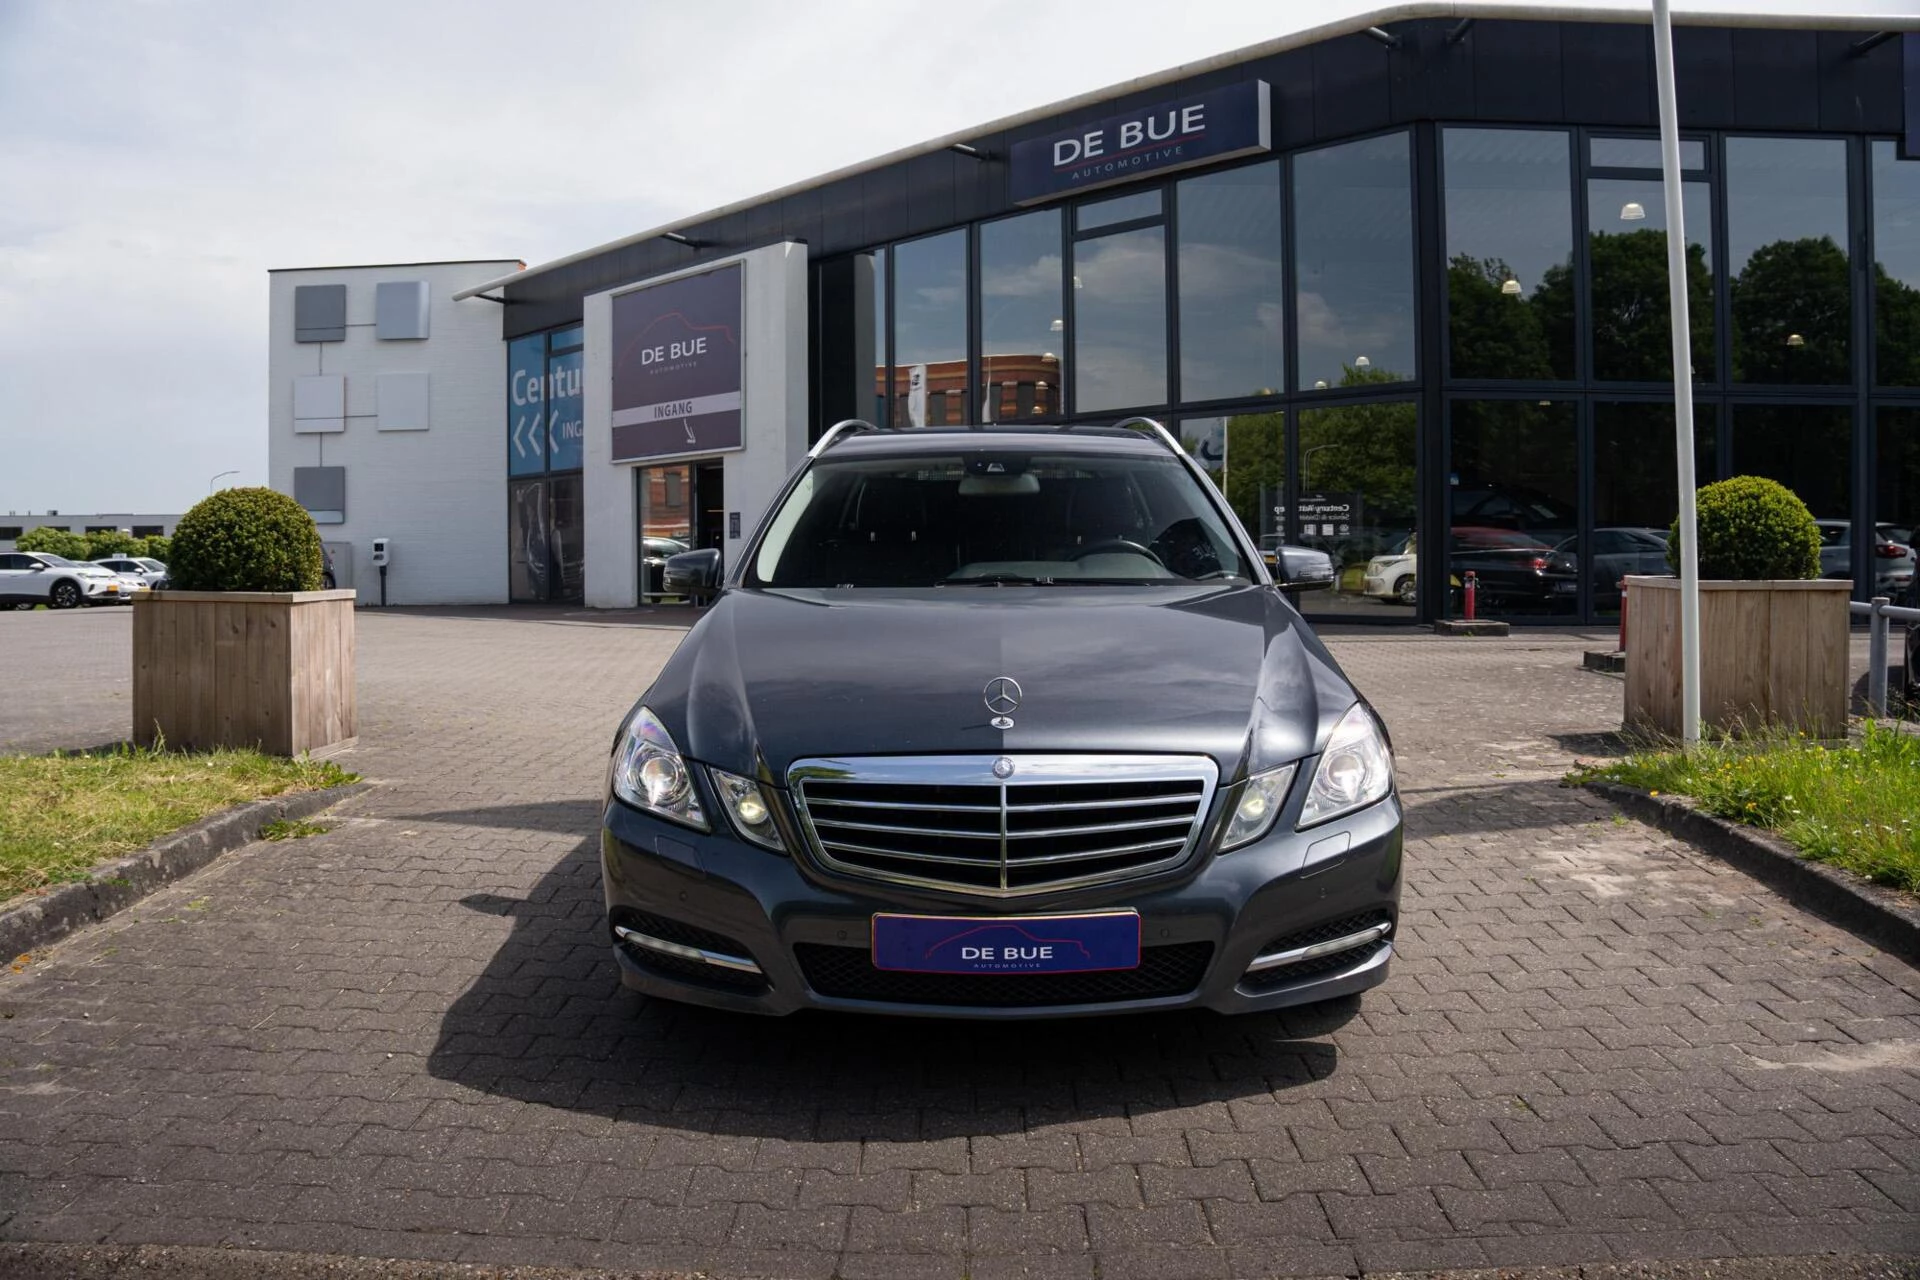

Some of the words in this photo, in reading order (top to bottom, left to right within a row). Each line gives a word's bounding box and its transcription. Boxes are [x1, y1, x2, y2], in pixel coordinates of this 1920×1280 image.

[1053, 130, 1104, 166] DE
[1120, 104, 1206, 149] BUE
[1072, 146, 1182, 179] AUTOMOTIVE
[641, 346, 664, 365] DE
[670, 337, 707, 359] BUE
[654, 401, 693, 419] INGANG
[961, 947, 995, 960] DE
[1004, 946, 1053, 960] BUE
